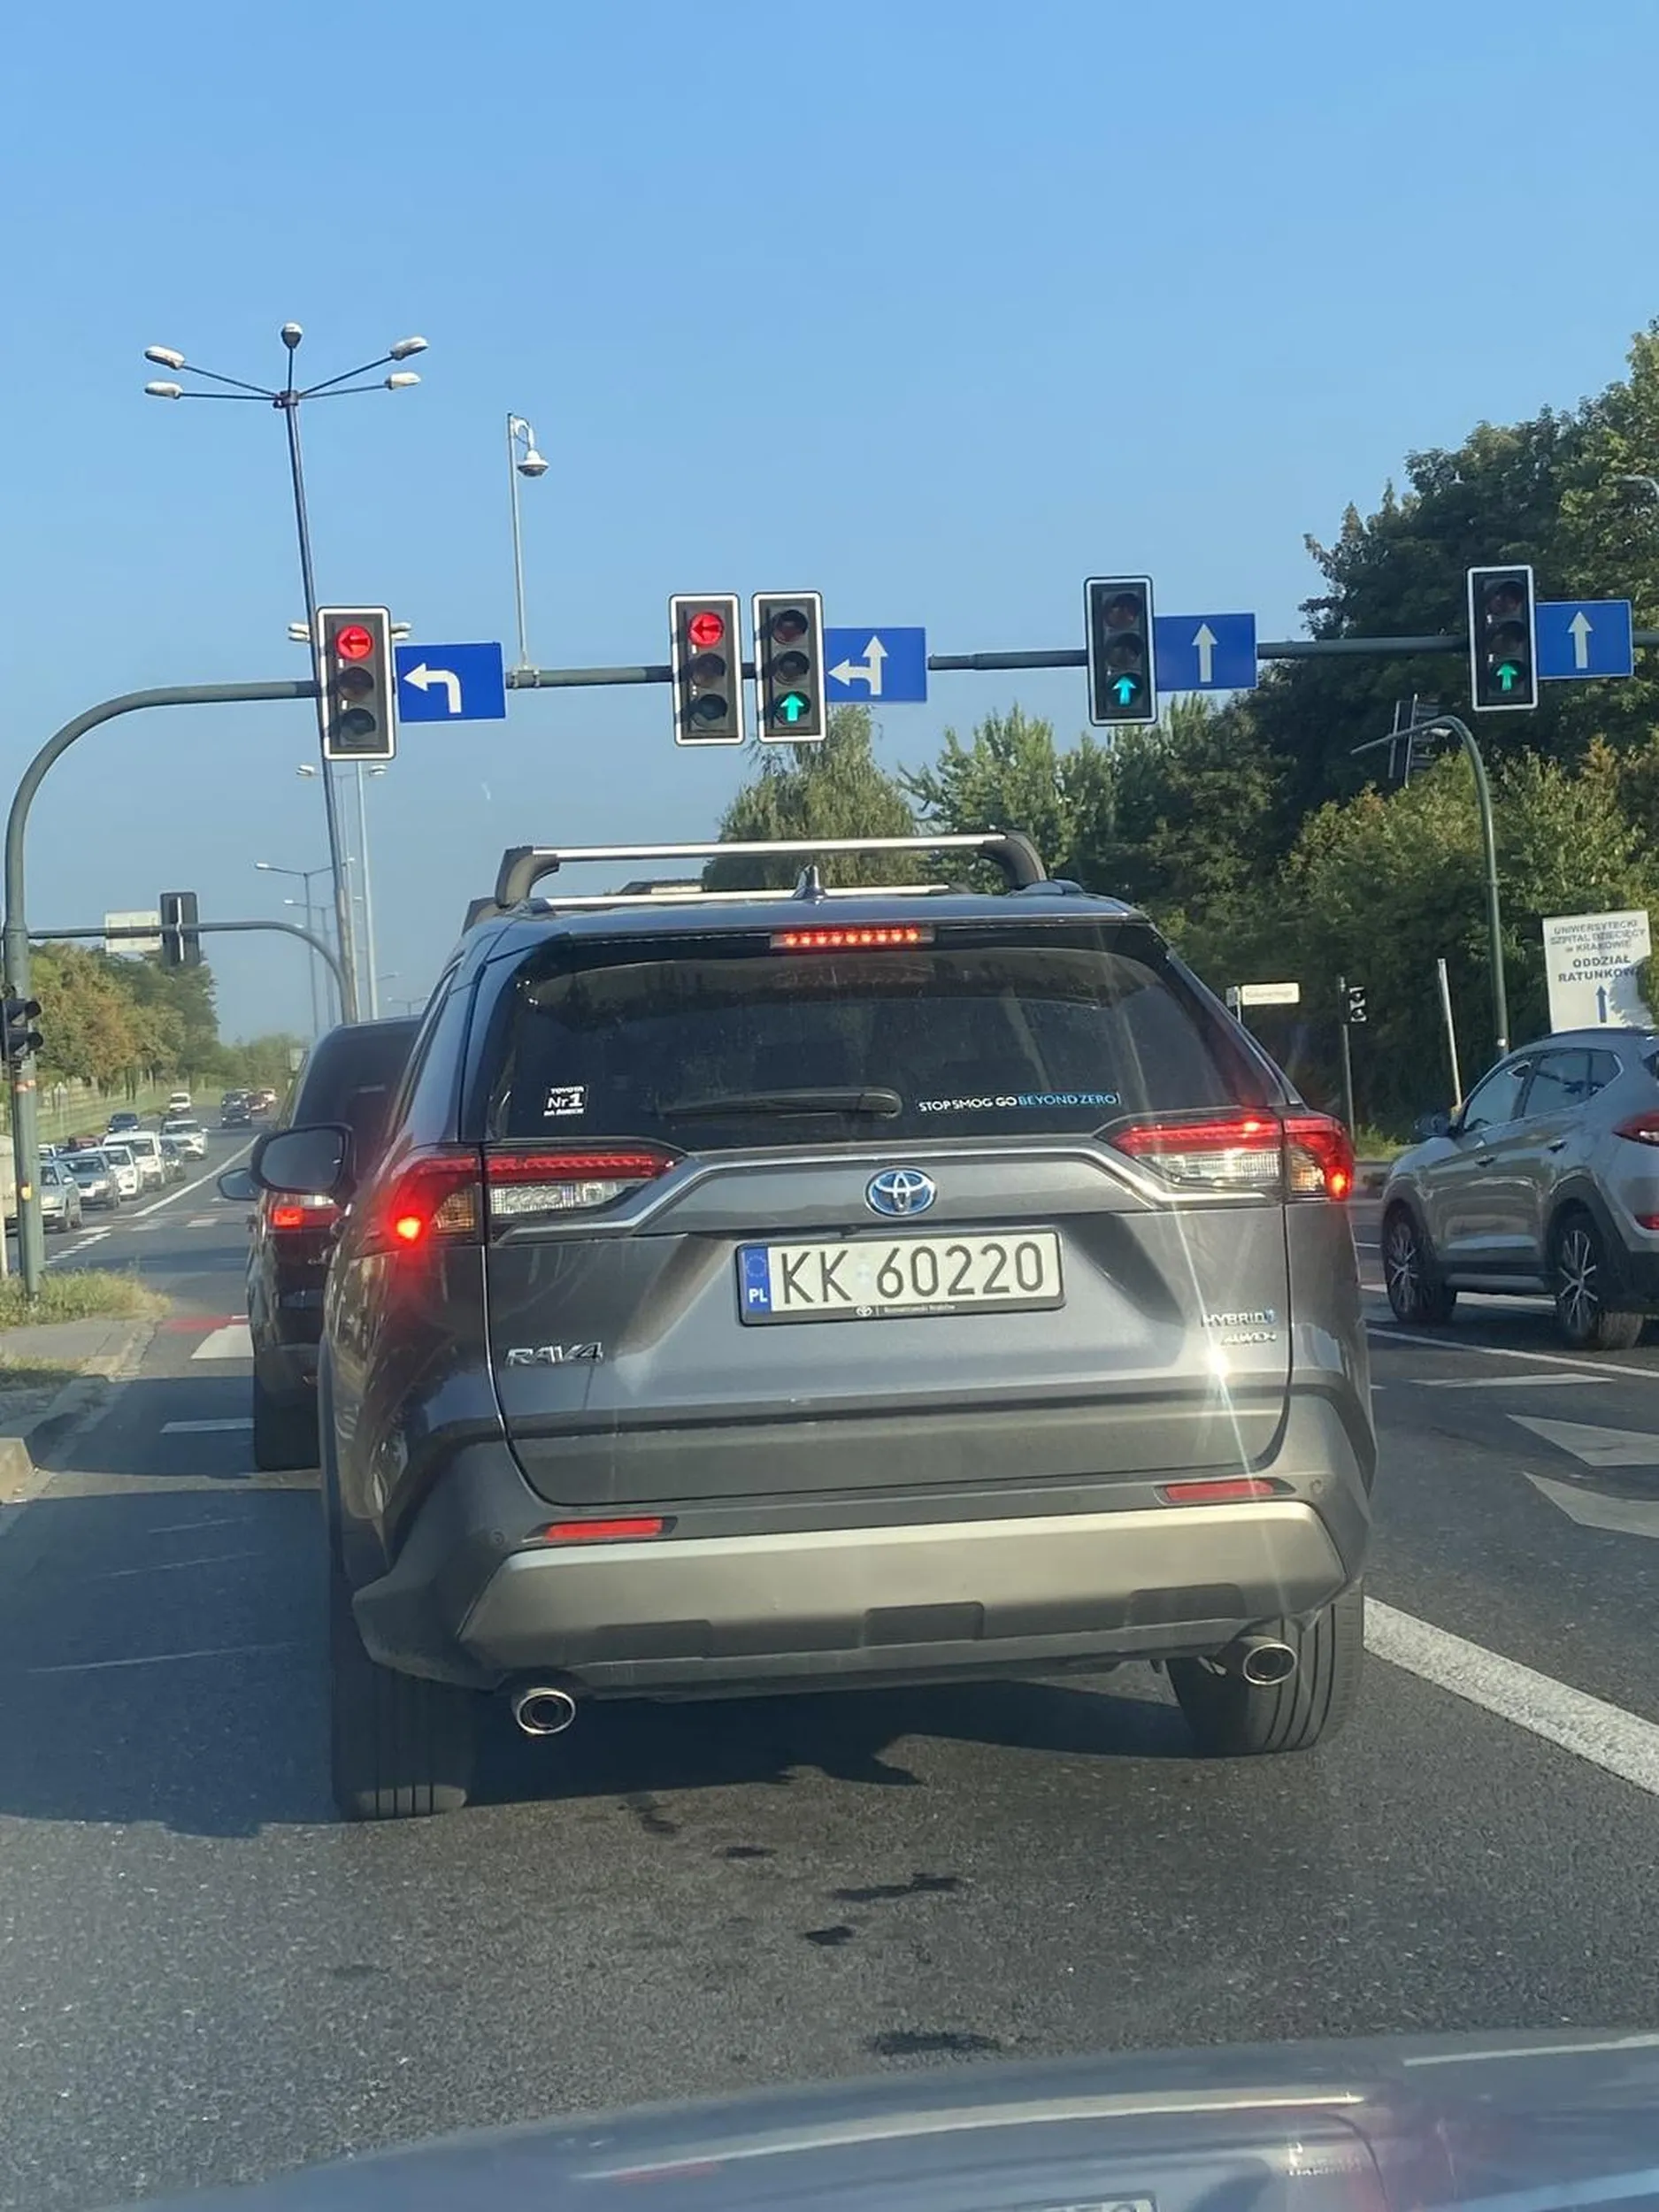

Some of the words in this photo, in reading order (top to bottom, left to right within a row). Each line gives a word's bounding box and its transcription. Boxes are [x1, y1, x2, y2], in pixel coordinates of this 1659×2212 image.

[1554, 919, 1639, 934] UNIWERSYTECKI
[1572, 955, 1632, 968] ODDZIAŁ
[549, 1086, 585, 1094] TOYOTA
[780, 1249, 852, 1305] KK
[876, 1241, 1045, 1299] 60220
[749, 1288, 768, 1304] PL
[1201, 1310, 1268, 1328] HYBRID
[506, 1341, 604, 1367] RAV4
